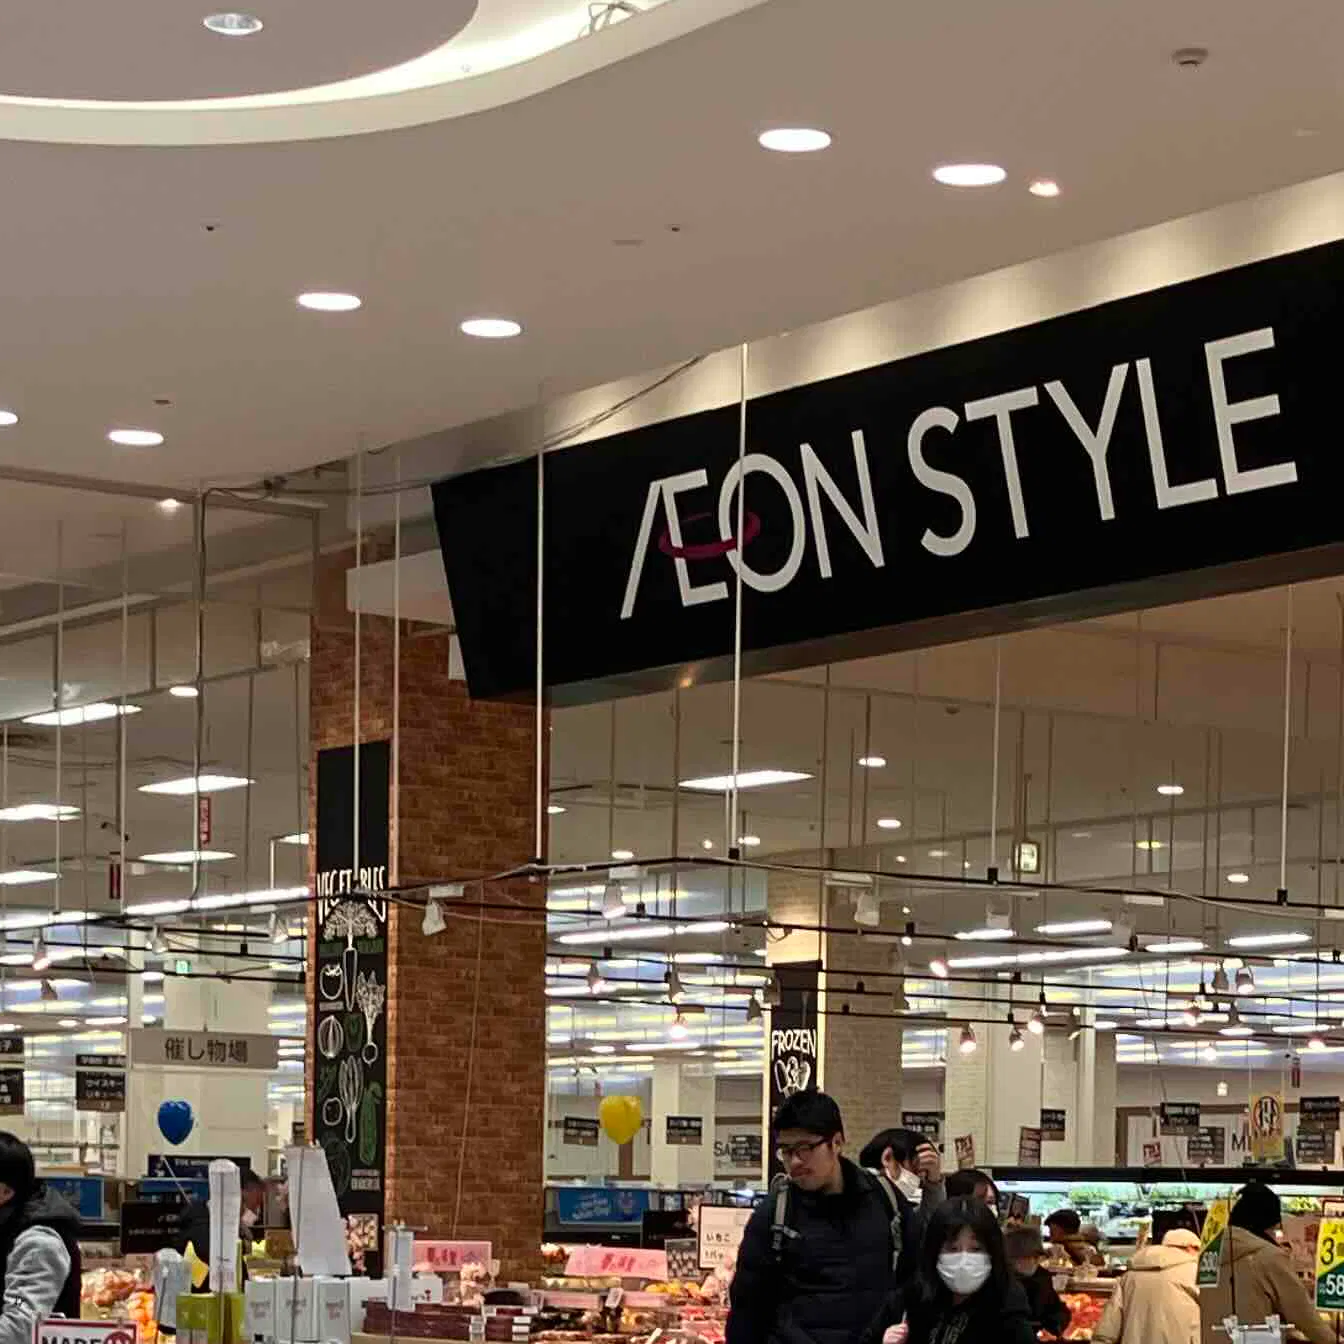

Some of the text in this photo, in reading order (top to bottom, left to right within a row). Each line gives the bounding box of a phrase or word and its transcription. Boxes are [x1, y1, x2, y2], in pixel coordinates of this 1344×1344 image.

[906, 326, 1299, 558] STYLE
[164, 1036, 249, 1065] 催し物場
[771, 1028, 816, 1061] FROZEN
